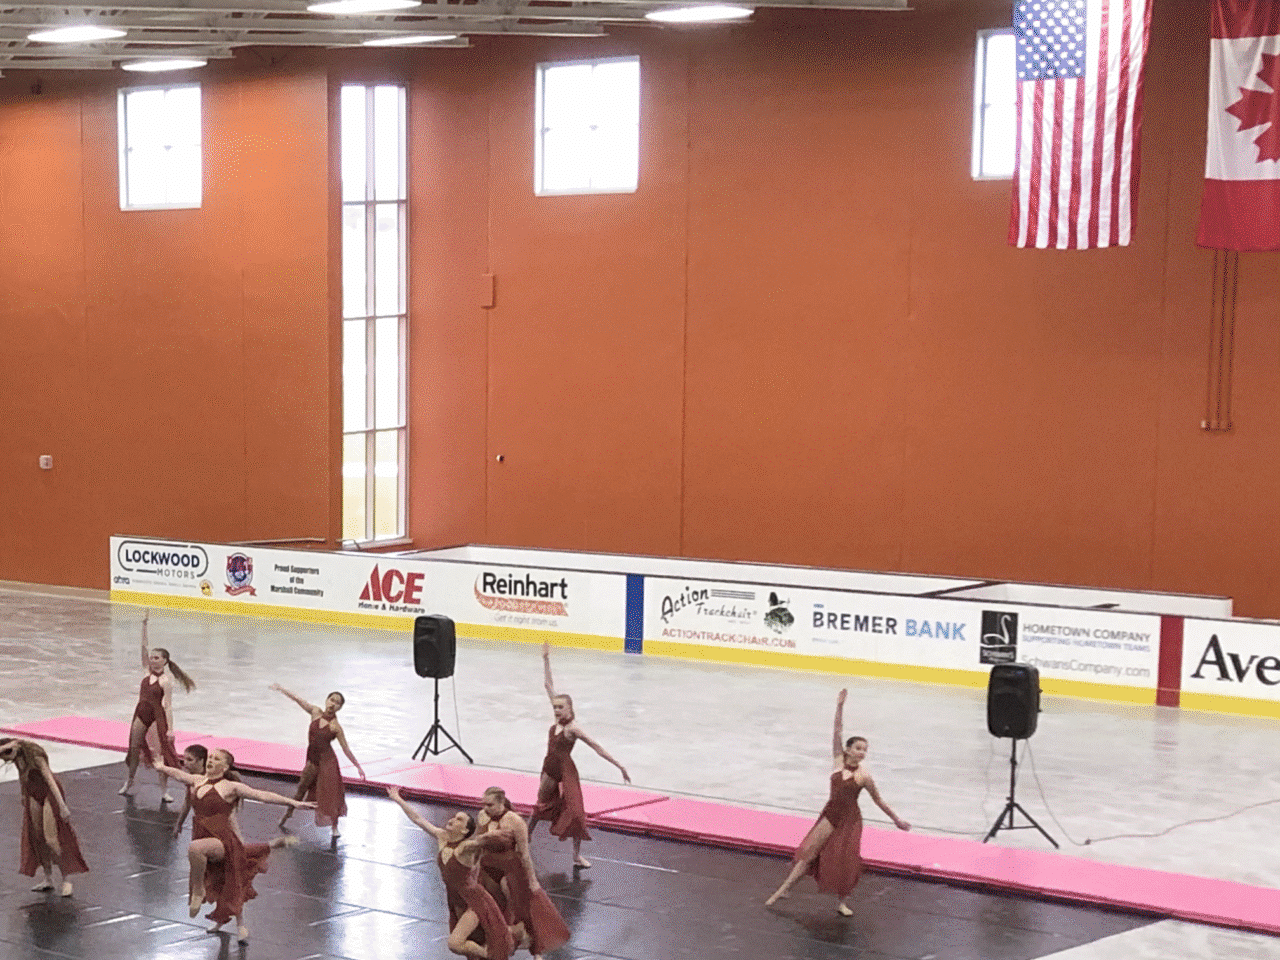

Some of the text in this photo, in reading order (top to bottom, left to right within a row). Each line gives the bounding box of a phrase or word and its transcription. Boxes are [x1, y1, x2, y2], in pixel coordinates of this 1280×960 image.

[125, 549, 200, 568] LOCKWOOD
[156, 568, 195, 580] MOTORS
[274, 563, 320, 575] Proud Supporters
[270, 585, 324, 597] Marshall Community
[359, 563, 426, 605] ACE
[482, 572, 568, 600] Reinhart
[358, 601, 379, 610] Home
[389, 604, 426, 614] Hardware
[660, 586, 709, 624] Action
[813, 611, 967, 641] BREMER BANK
[1022, 623, 1151, 642] HOMETOWN COMPANY
[661, 628, 797, 648] ACTIONTRACKCHAIR.COM
[1190, 633, 1280, 686] Ave
